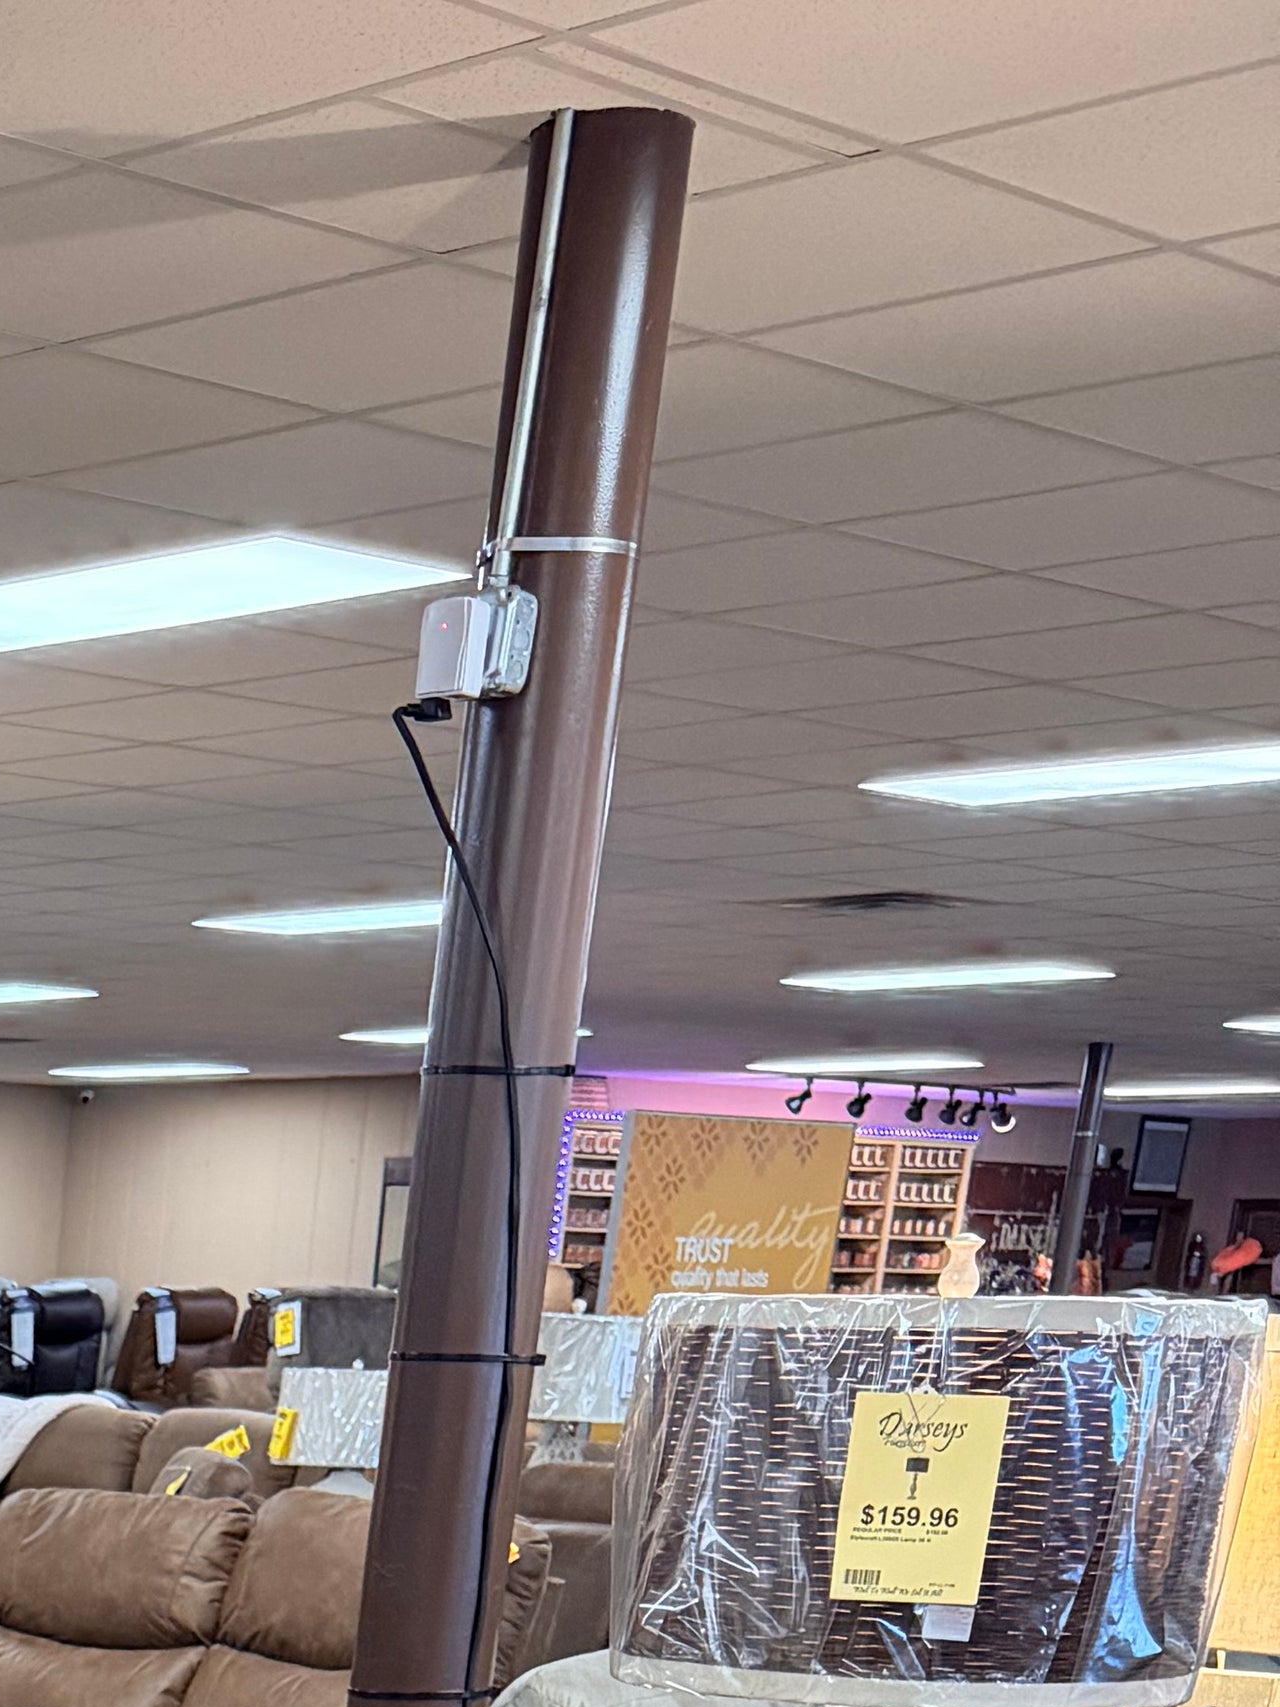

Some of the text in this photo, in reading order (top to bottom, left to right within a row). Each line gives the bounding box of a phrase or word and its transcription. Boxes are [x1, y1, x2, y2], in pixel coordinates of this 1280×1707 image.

[674, 1236, 734, 1264] TRUST
[671, 1265, 769, 1290] quality that lasts
[879, 1412, 968, 1452] Darseys
[860, 1504, 959, 1529] $159.96
